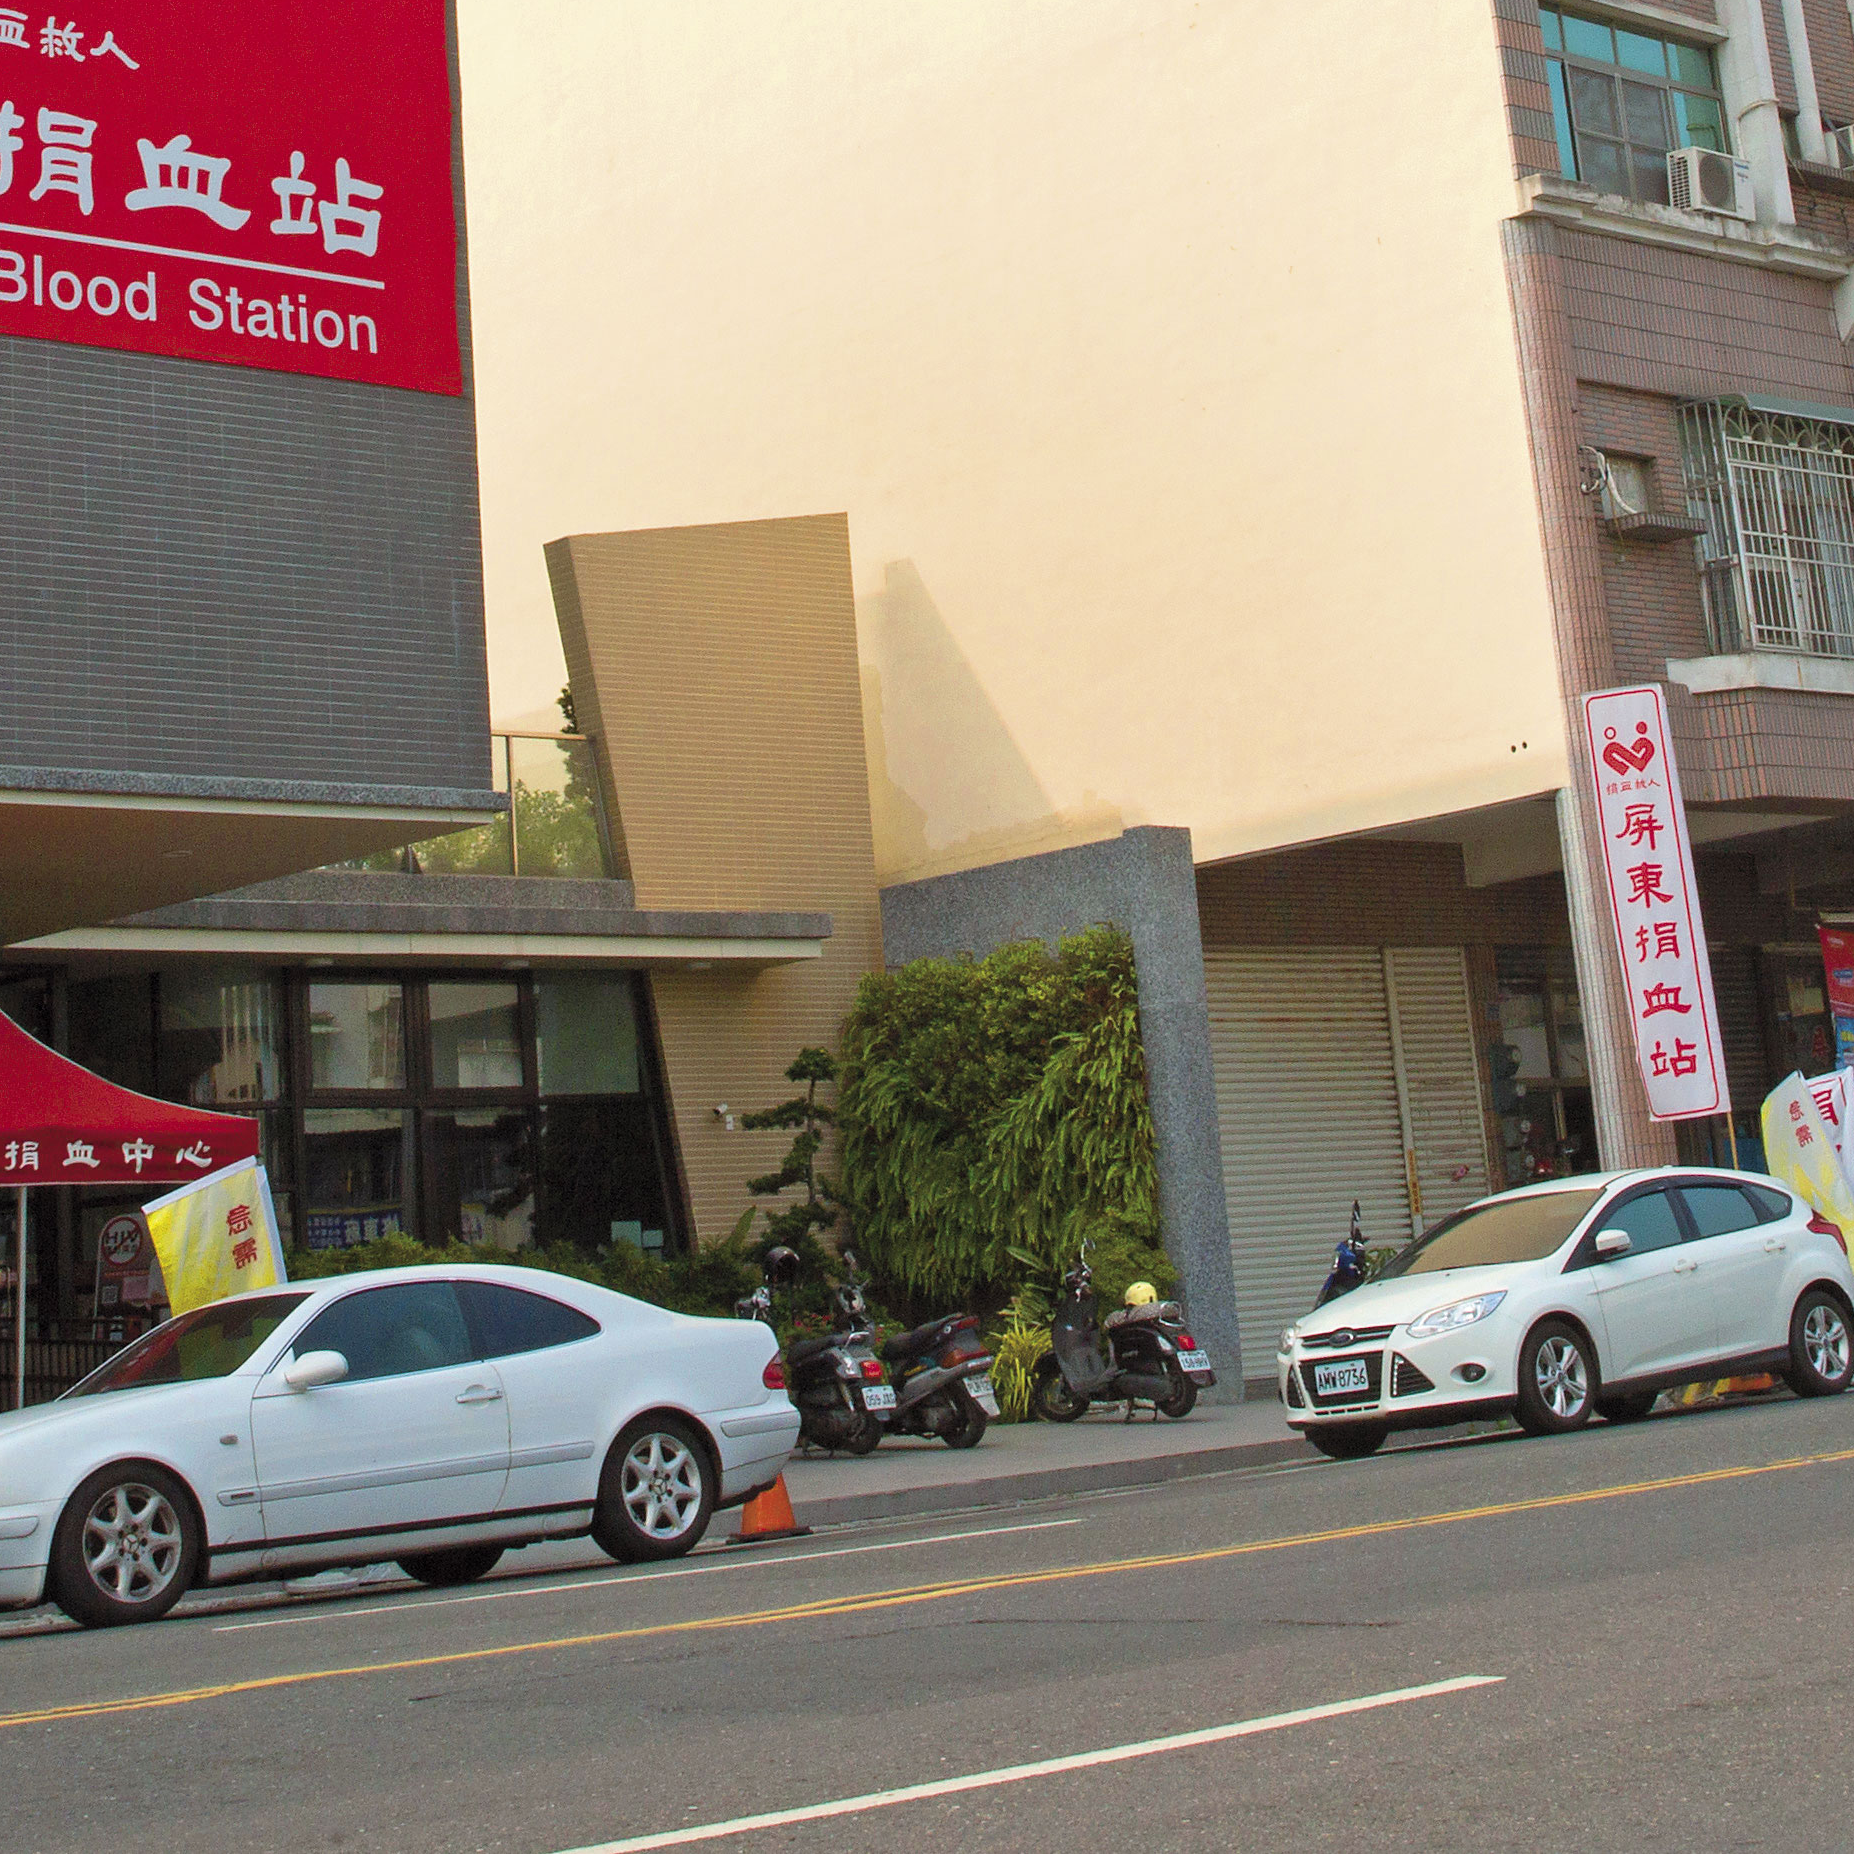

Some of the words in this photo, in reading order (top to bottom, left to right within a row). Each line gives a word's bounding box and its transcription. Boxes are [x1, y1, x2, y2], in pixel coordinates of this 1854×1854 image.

[188, 278, 379, 354] Station
[1616, 803, 1697, 1078] 屏東捐血站
